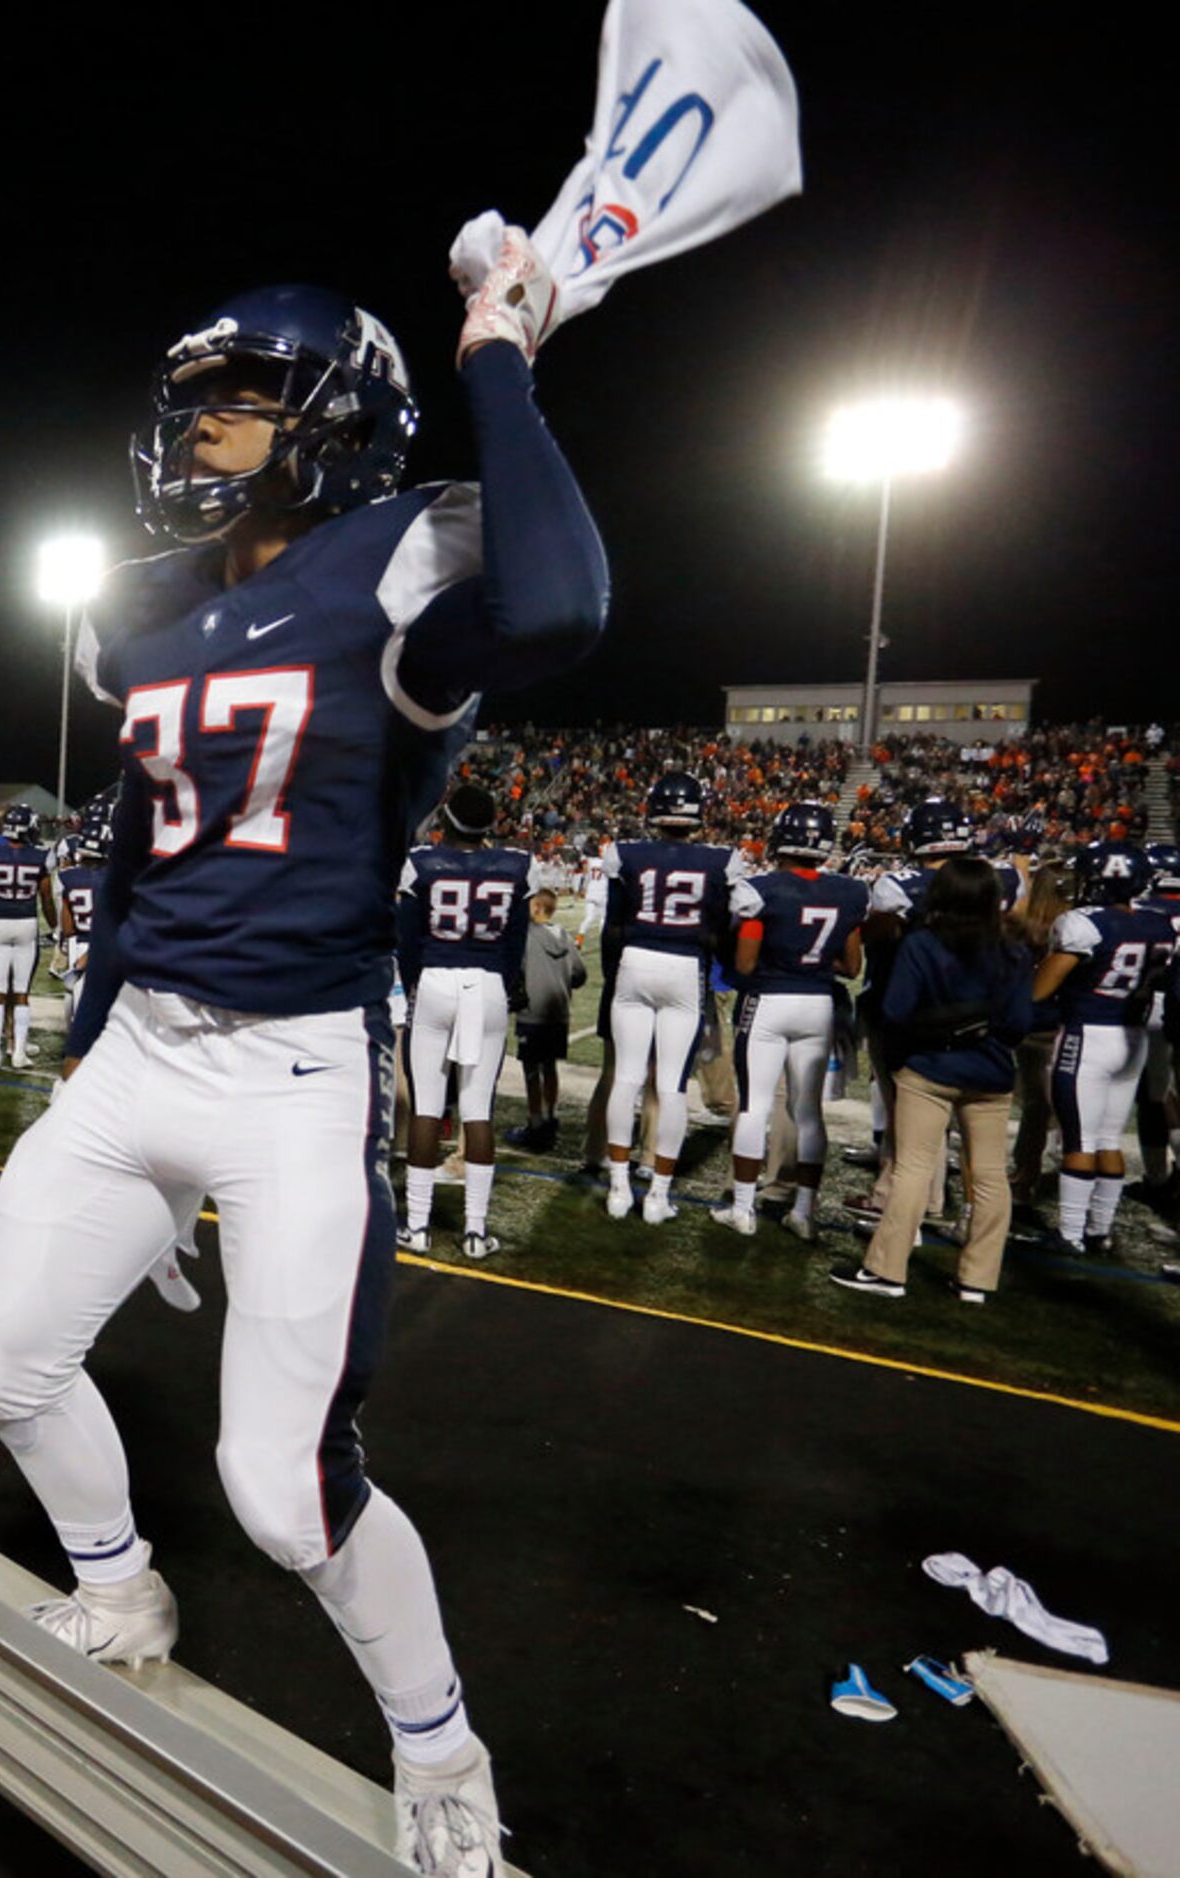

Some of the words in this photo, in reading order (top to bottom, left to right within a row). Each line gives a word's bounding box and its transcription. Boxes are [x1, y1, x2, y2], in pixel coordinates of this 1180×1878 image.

[120, 664, 315, 857] 37
[1103, 854, 1132, 877] A
[429, 879, 514, 941] 83
[636, 868, 707, 926] 12
[801, 905, 838, 965] 7
[1057, 1033, 1082, 1076] ALLEN
